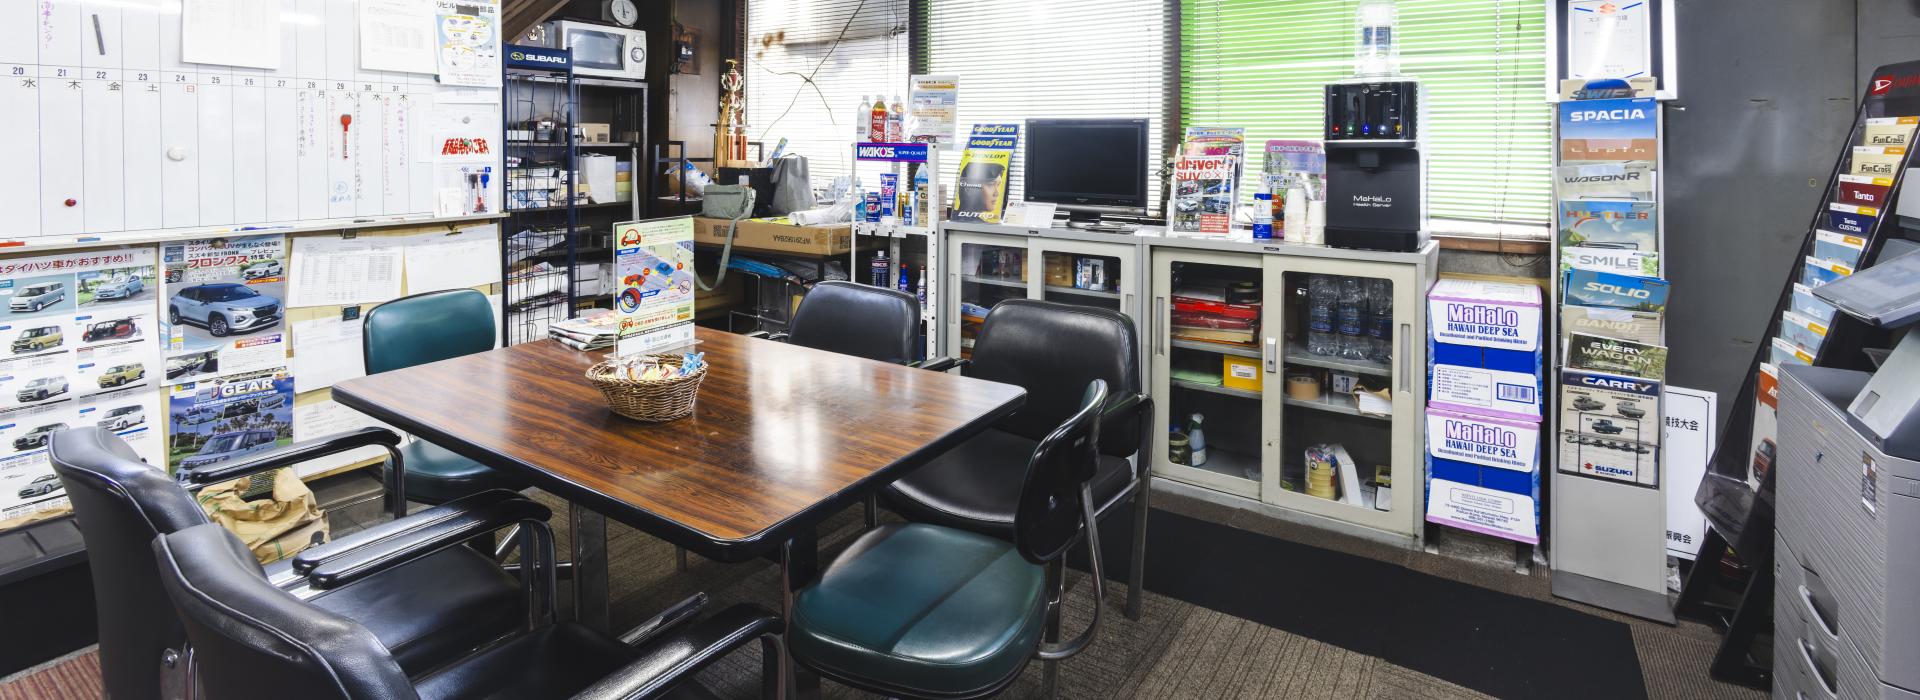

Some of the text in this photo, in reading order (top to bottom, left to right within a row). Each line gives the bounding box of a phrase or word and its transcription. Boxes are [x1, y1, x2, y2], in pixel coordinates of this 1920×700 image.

[525, 54, 567, 64] SUBARU
[12, 67, 24, 75] 20
[57, 69, 67, 77] 21
[96, 71, 107, 79] 22
[138, 73, 148, 81] 23
[175, 74, 186, 82] 24
[211, 76, 220, 84] 25
[22, 79, 36, 88] 水
[68, 79, 81, 90] 木
[108, 81, 121, 91] 金
[244, 78, 254, 86] 26
[307, 81, 316, 89] 28
[148, 83, 159, 92] 土
[186, 85, 195, 93] 日
[317, 89, 325, 98] 月
[345, 91, 354, 99] 火
[373, 92, 381, 100] 水
[399, 93, 408, 101] 木
[1570, 109, 1645, 122] SPACIA
[974, 126, 1015, 134] GOODYEAR
[971, 139, 1013, 147] GOODYEAR
[1872, 135, 1905, 144] FunCross
[1861, 164, 1891, 173] FunCross
[1854, 190, 1874, 201] Tanto
[958, 211, 994, 219] DUTRO
[1566, 210, 1649, 220] HUSTLER
[1838, 224, 1862, 232] CUSTOM
[188, 255, 250, 269] フロンクス
[1579, 255, 1639, 268] SMILE
[1583, 282, 1650, 298] SOLIO
[1447, 303, 1518, 327] MaHaLo
[1447, 322, 1519, 337] HAWAII DEEP SEA
[1590, 341, 1646, 356] EVERY
[1581, 346, 1651, 365] WAGON
[221, 378, 275, 396] GEAR
[1581, 377, 1652, 392] CARRY
[1445, 419, 1517, 449] MaHaLo
[1445, 439, 1517, 458] HAWAII DEEP SEA
[1595, 465, 1633, 476] SUZUKI
